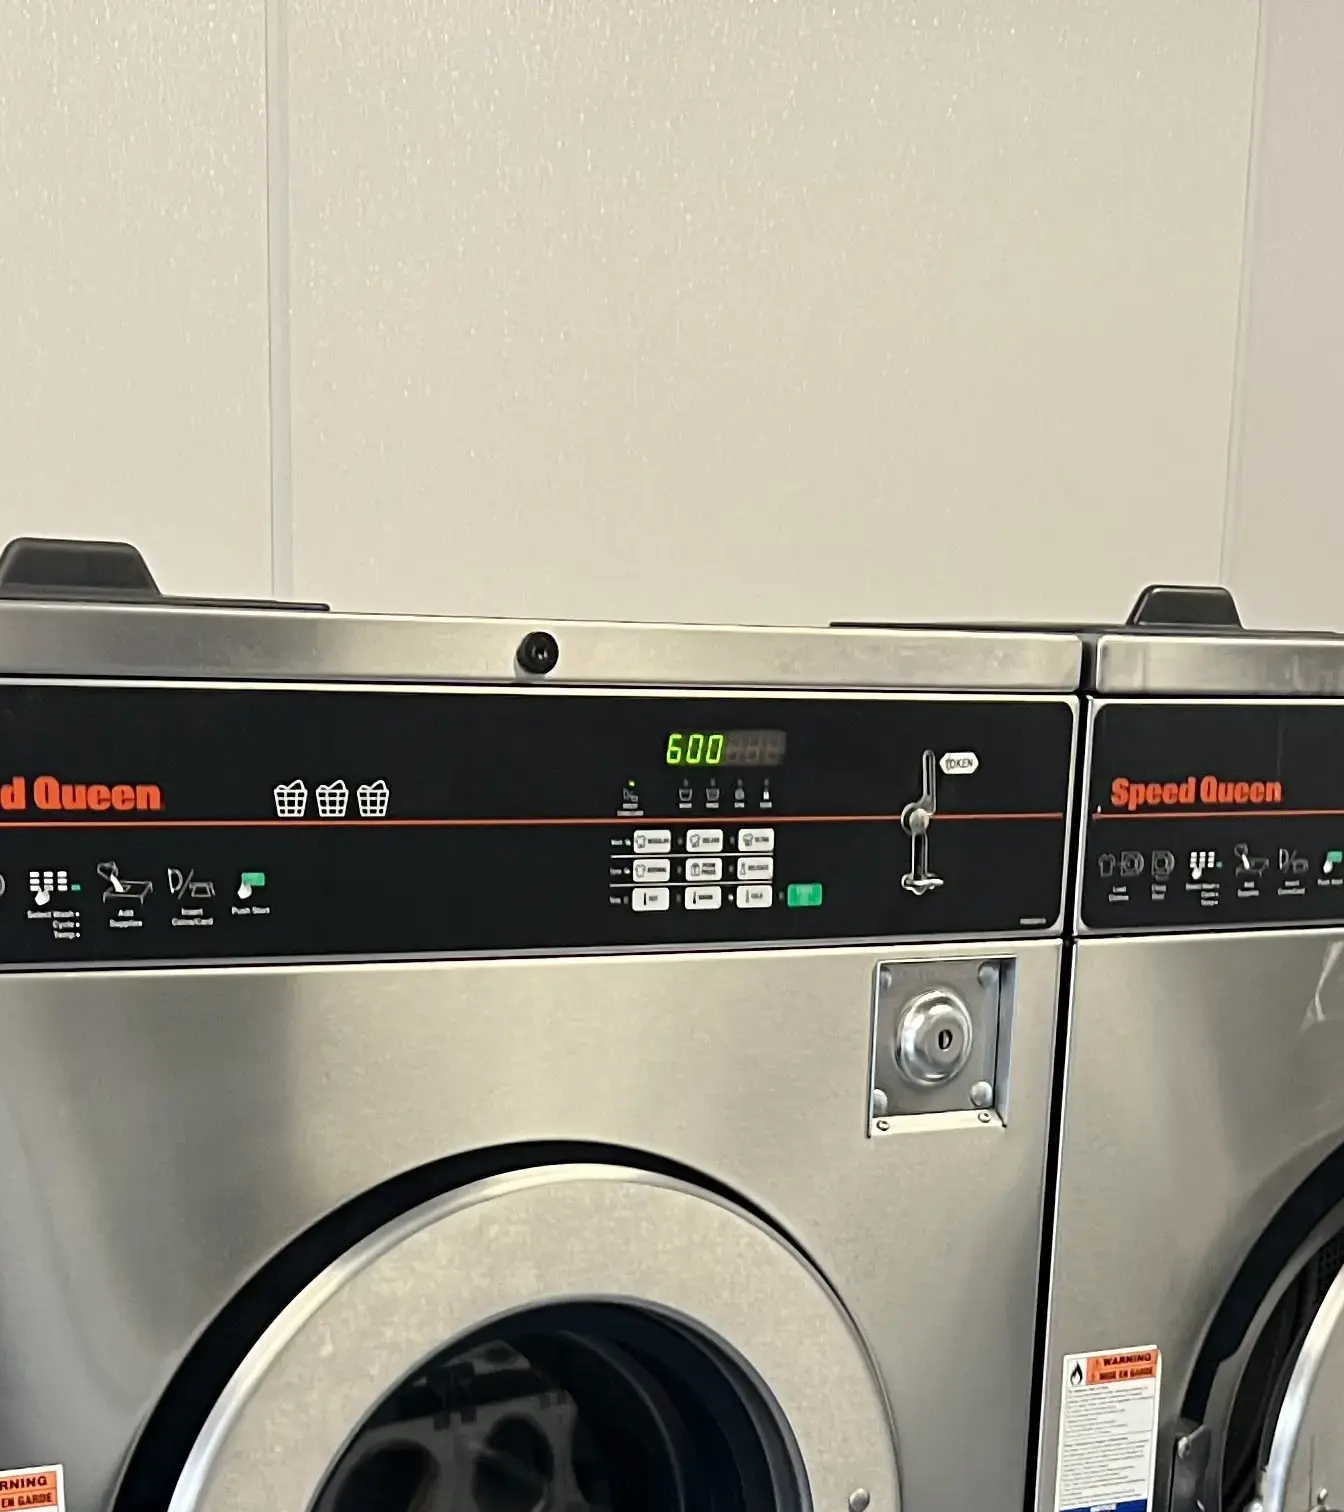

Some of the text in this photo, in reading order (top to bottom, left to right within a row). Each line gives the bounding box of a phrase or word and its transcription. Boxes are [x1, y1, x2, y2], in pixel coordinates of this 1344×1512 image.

[945, 758, 973, 770] TOKEN
[33, 775, 161, 810] Queen
[1111, 775, 1282, 811] Speed Queen
[1, 1498, 15, 1508] EN
[17, 1492, 52, 1506] GARDE
